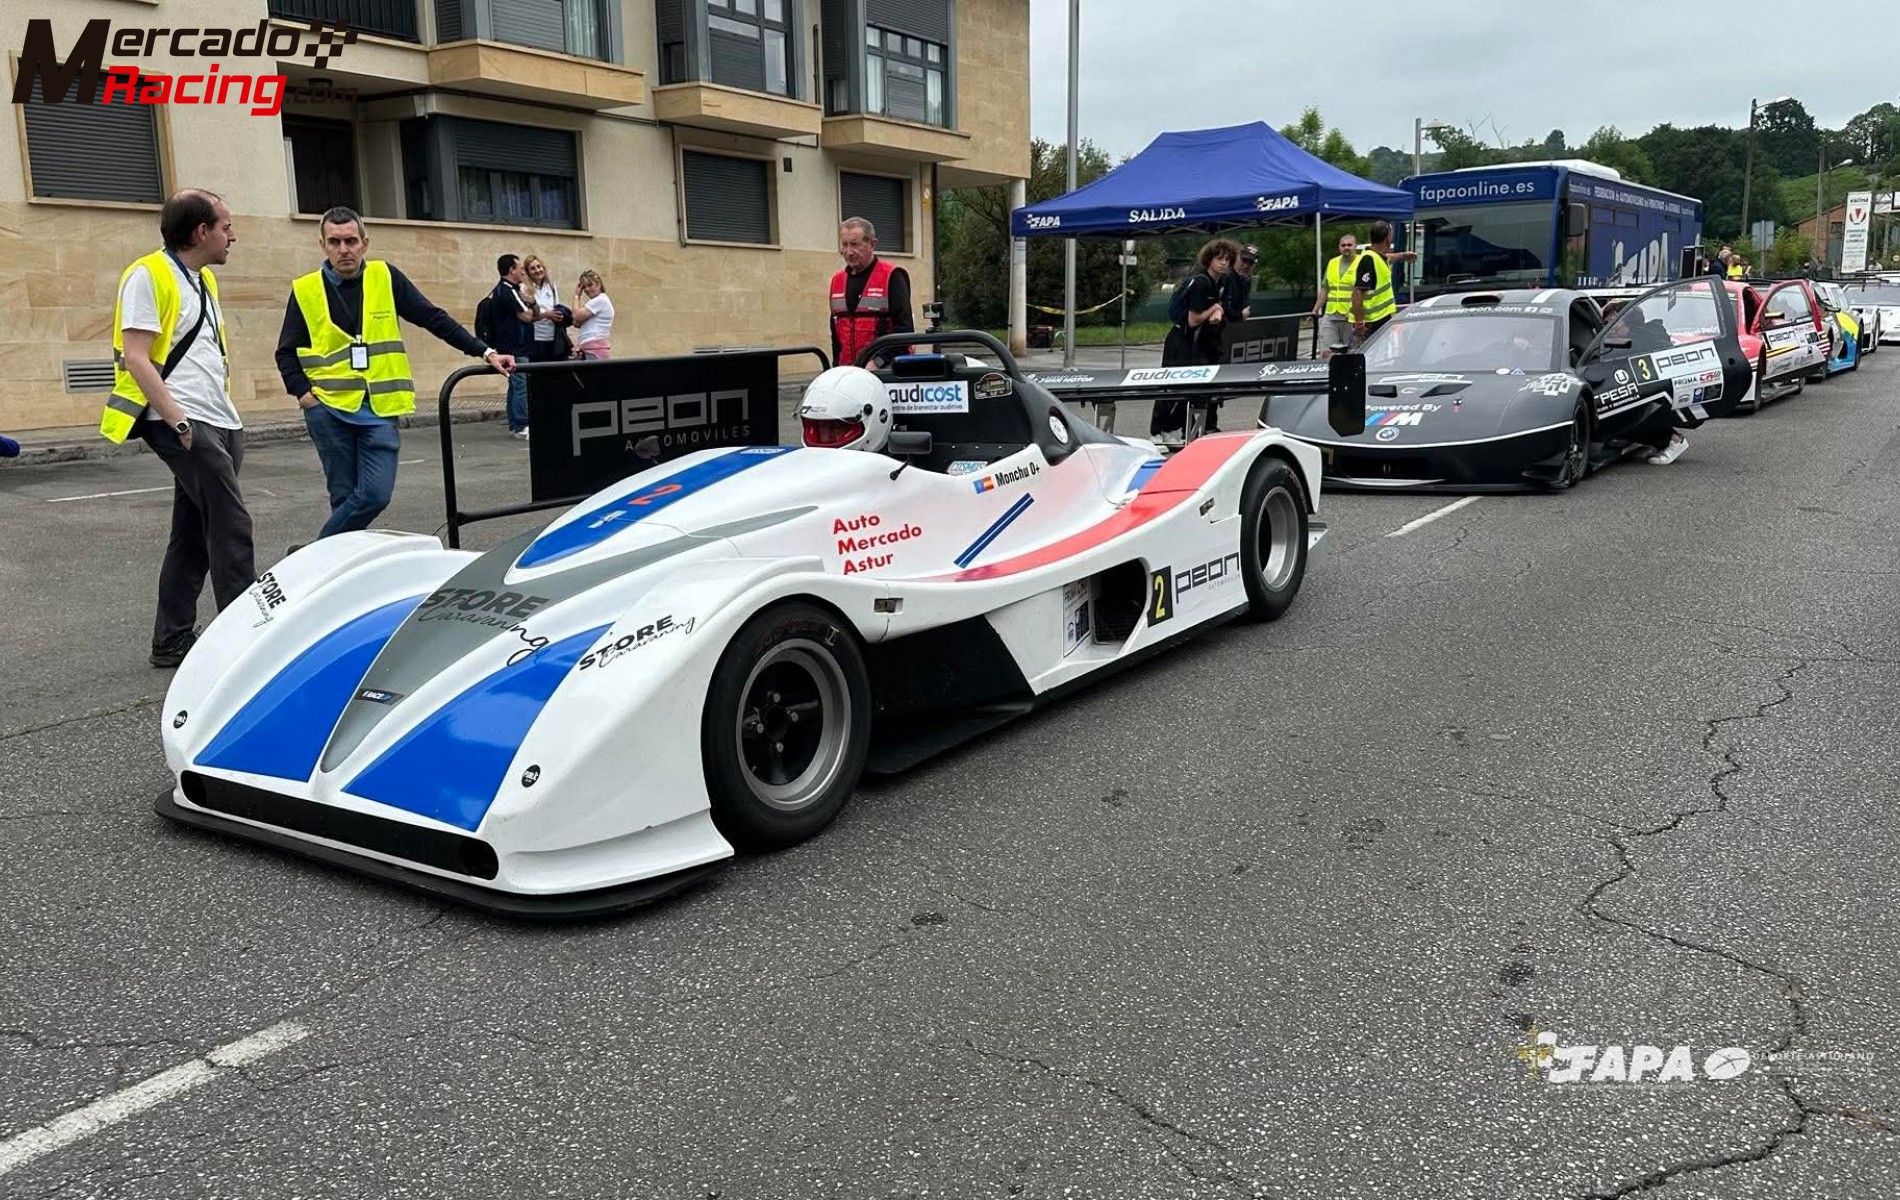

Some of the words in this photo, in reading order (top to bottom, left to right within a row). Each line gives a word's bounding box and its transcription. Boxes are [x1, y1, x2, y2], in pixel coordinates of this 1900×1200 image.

[1420, 180, 1535, 202] fapaonline.es
[1264, 195, 1299, 211] FAPA
[1033, 215, 1061, 228] FAPA
[1128, 207, 1186, 223] SALIDA
[1130, 366, 1211, 382] audicost
[1638, 358, 1651, 381] 3
[889, 384, 962, 403] audicost
[1422, 403, 1442, 413] By
[625, 425, 750, 452] AOMOVILES
[995, 465, 1030, 487] Monchu
[833, 514, 880, 535] Auto
[837, 523, 922, 555] Mercado
[843, 551, 893, 575] Astur
[257, 572, 287, 609] STORE
[1154, 574, 1166, 620] 2
[419, 588, 551, 619] STORE
[579, 614, 674, 672] STORE
[598, 616, 697, 668] Caravaning
